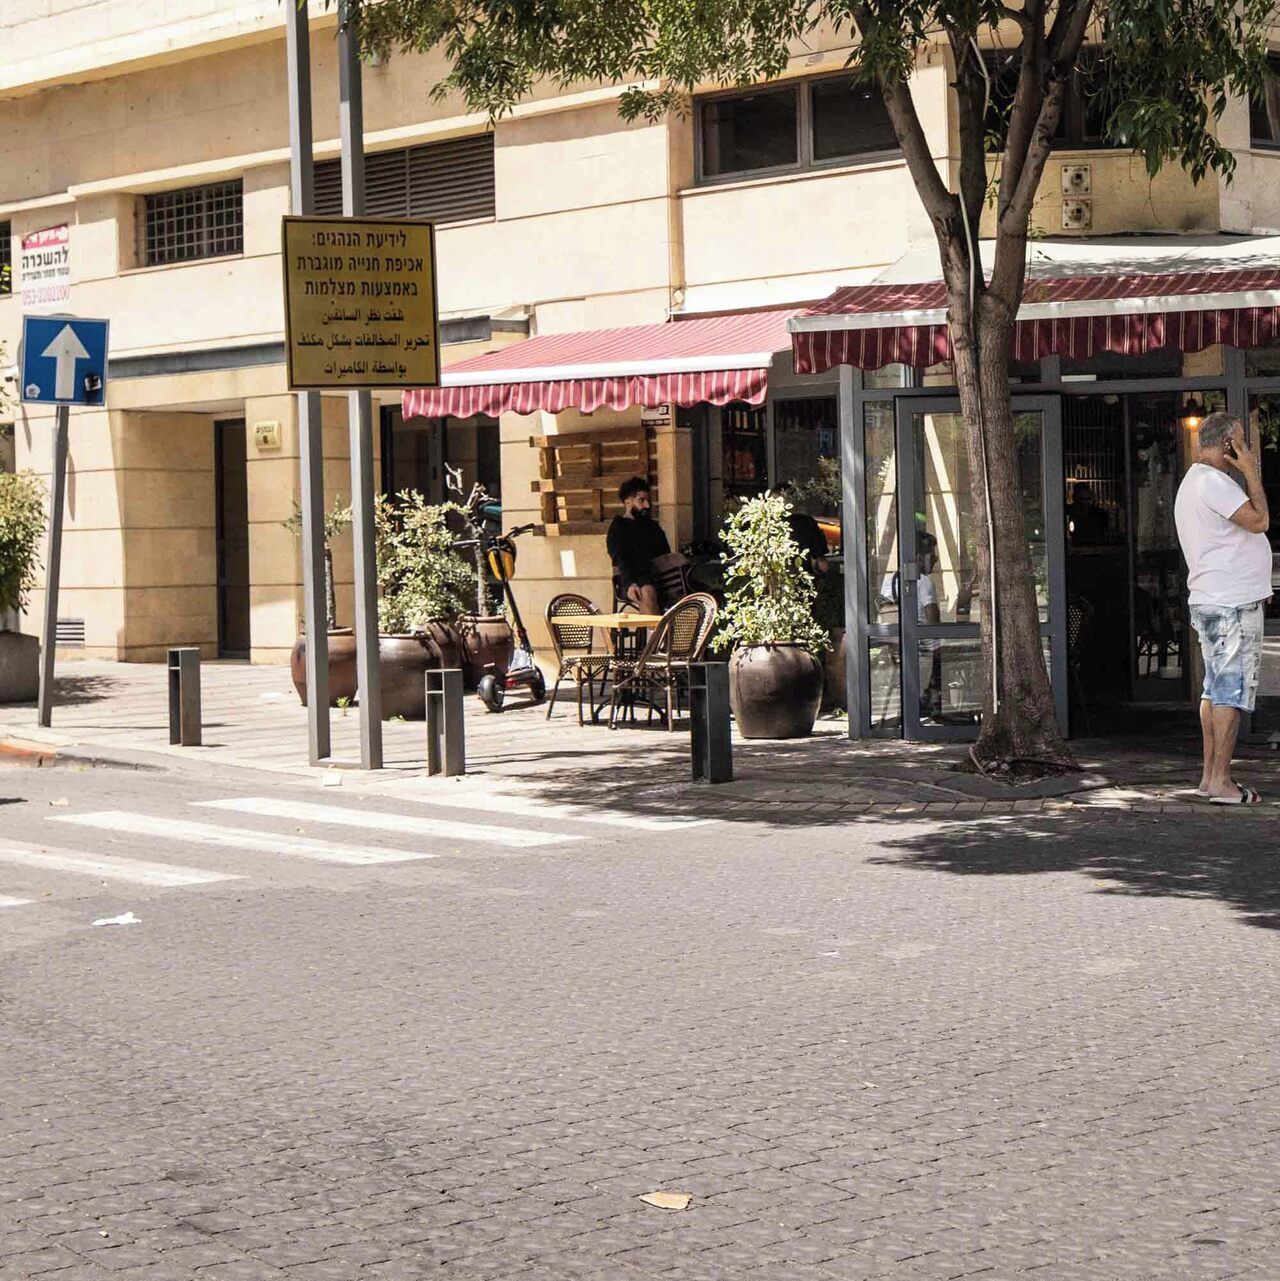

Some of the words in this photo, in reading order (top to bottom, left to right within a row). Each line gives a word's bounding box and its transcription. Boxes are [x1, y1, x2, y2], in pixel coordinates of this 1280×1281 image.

[312, 231, 361, 246] הנהגים:
[366, 230, 406, 247] לידיעת
[22, 246, 69, 269] להשכרה
[297, 256, 343, 271] מוגברת
[348, 257, 380, 271] חנייה
[385, 257, 424, 272] אכיפת
[305, 278, 355, 296] מצלמות
[361, 281, 418, 296] באמצעות
